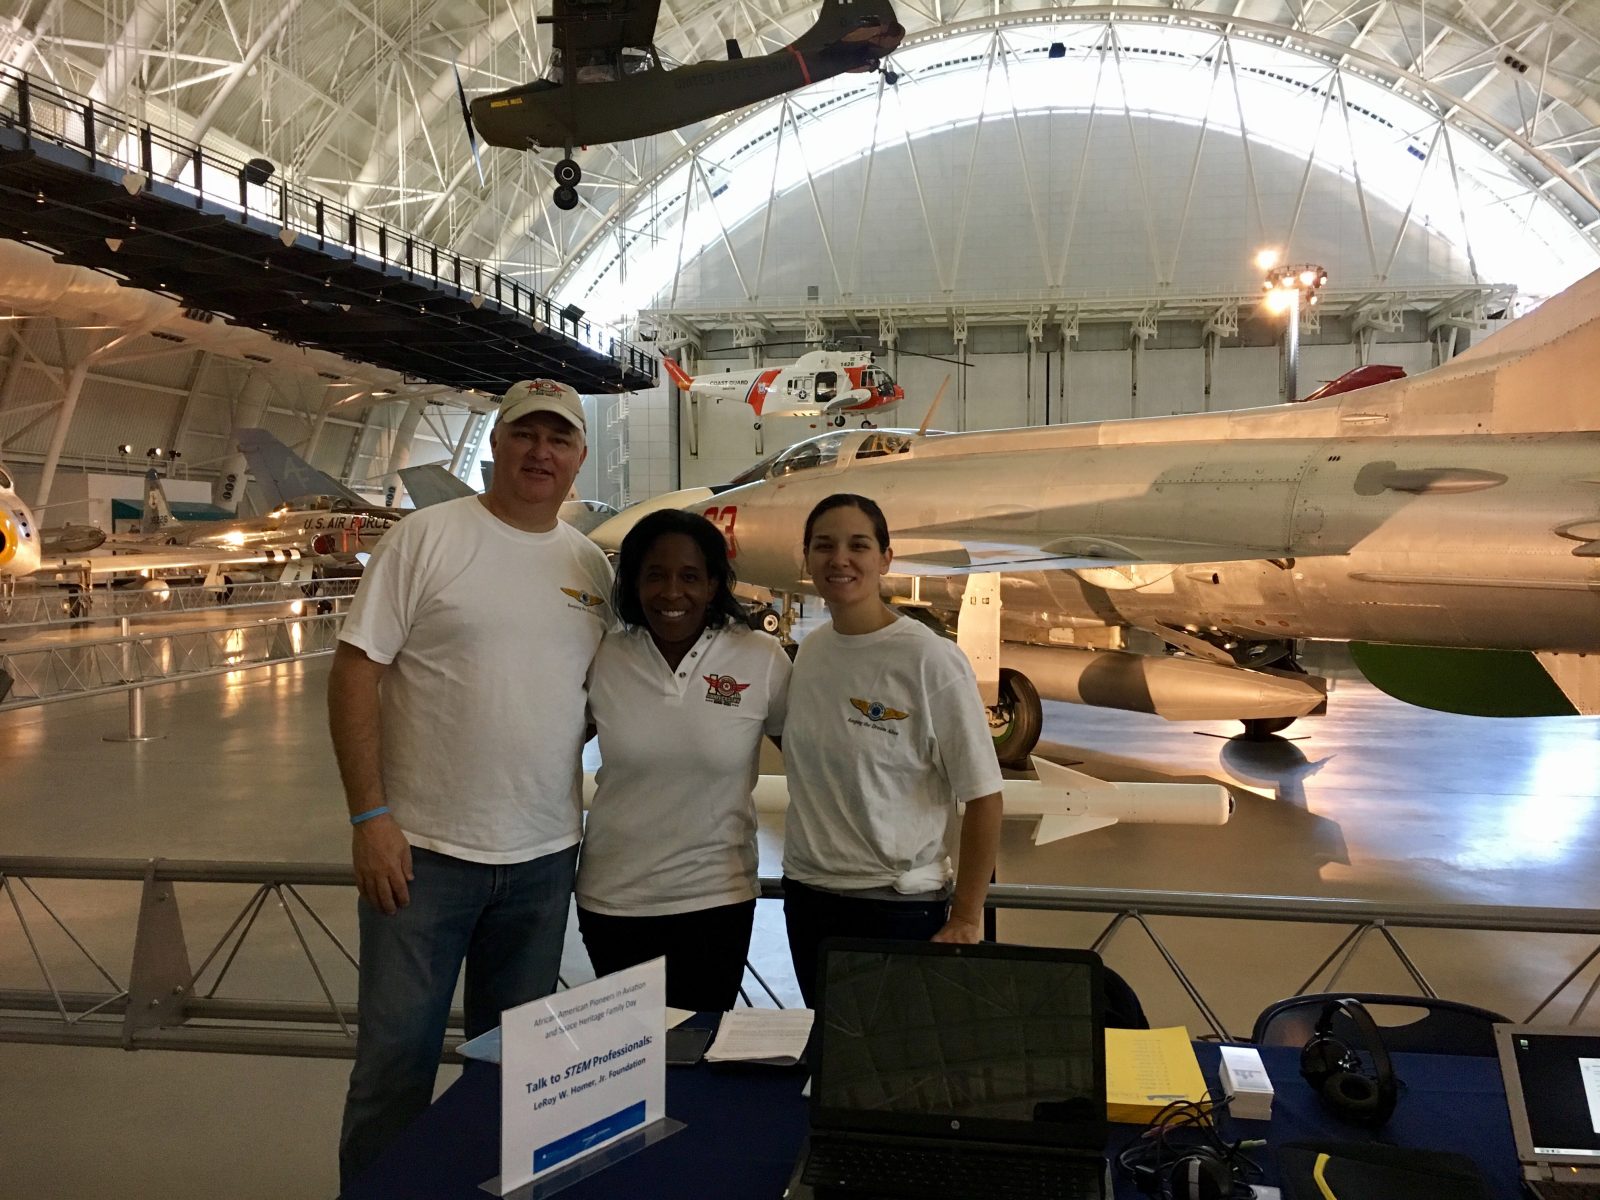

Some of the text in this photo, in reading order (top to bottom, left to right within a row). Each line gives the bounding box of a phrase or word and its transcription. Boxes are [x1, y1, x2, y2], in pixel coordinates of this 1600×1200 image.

[303, 516, 391, 529] U.S. AIR FORCE
[703, 505, 738, 560] 3
[589, 993, 615, 1008] Pioneers
[622, 981, 646, 995] Aviation
[545, 1027, 558, 1039] and
[578, 1012, 605, 1026] Heritage
[605, 1004, 625, 1017] Family
[625, 1000, 637, 1009] Day
[525, 1035, 653, 1094] Talk to STEM Professionals:
[533, 1057, 646, 1111] LeRoy W. Homer, Jr. Foundation
